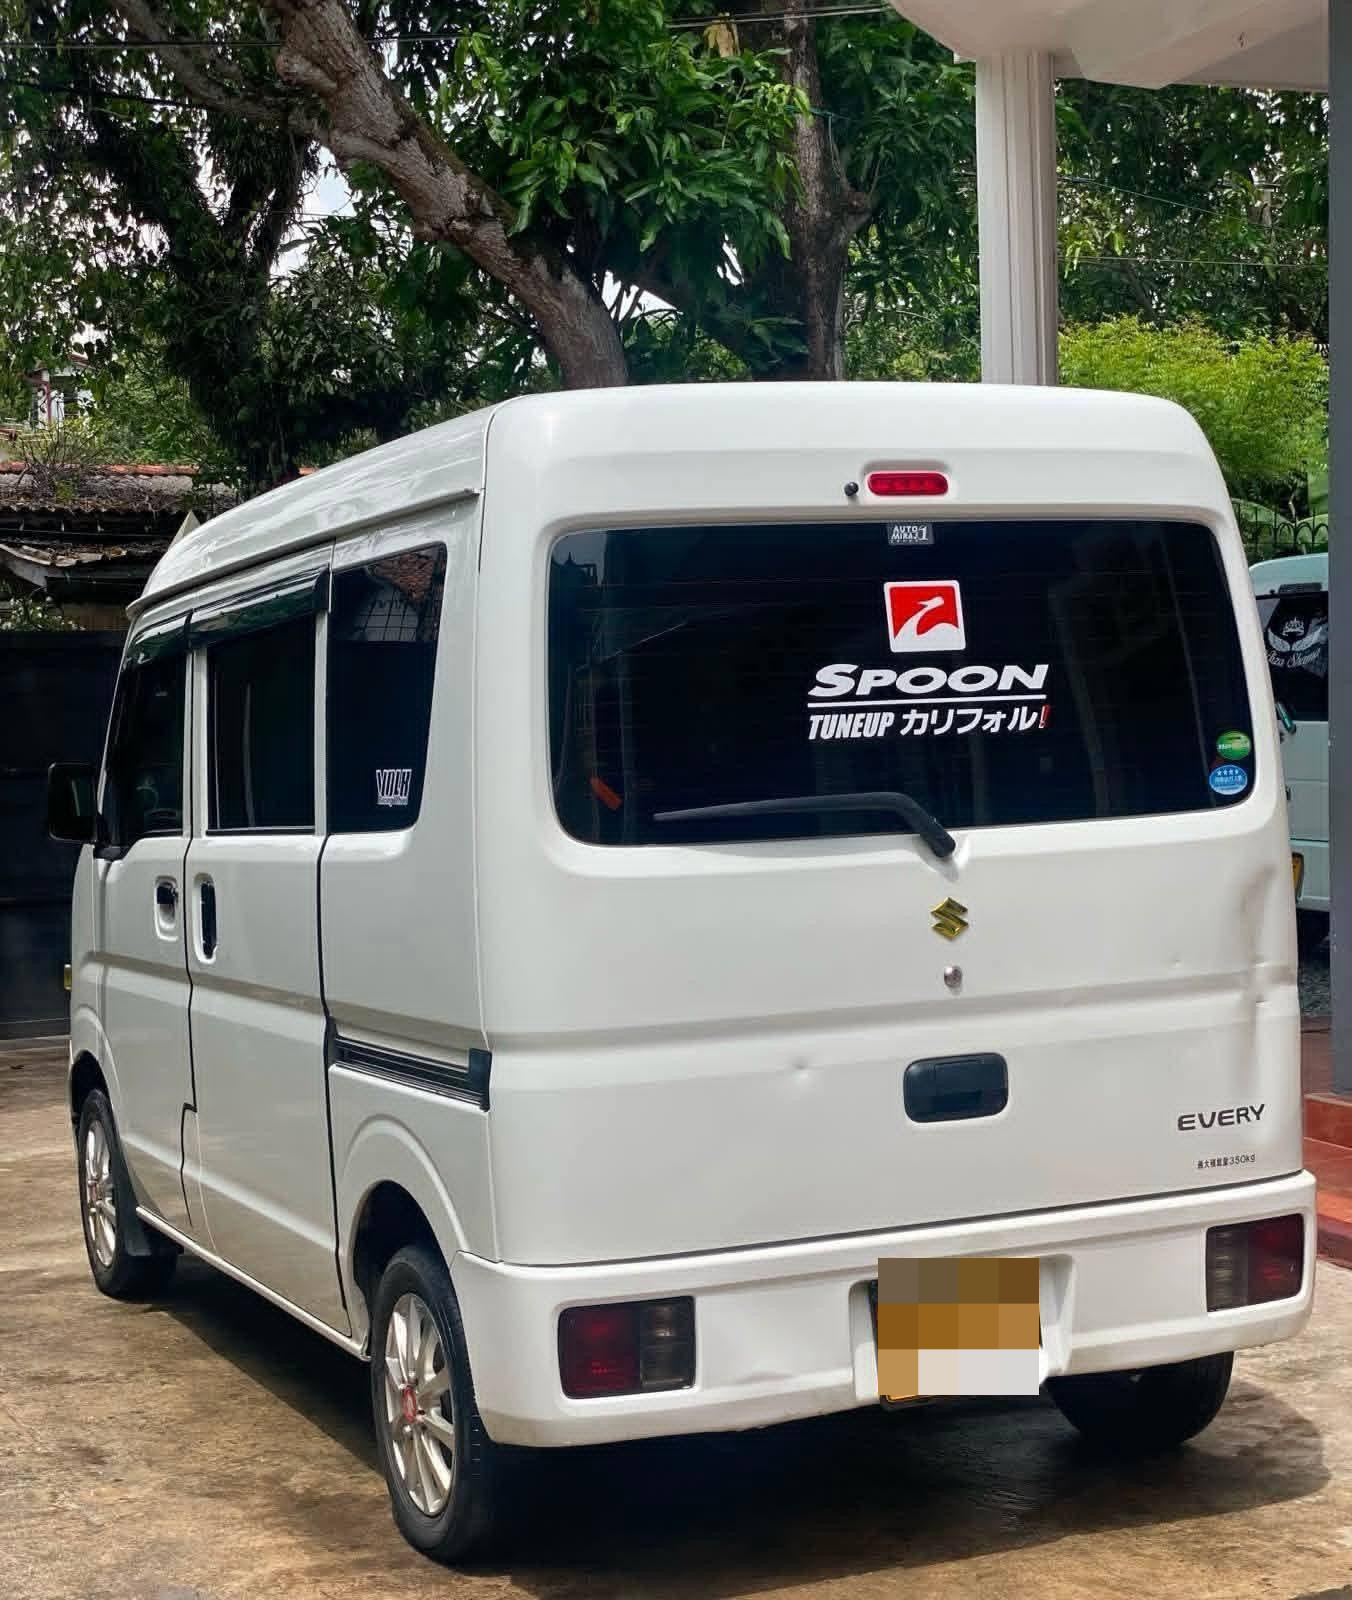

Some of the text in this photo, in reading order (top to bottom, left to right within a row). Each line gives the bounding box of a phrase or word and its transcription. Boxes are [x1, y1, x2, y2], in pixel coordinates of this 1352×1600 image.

[893, 524, 918, 533] AUTO
[808, 664, 1049, 697] SPOON
[808, 711, 895, 740] TUNEUP
[1177, 1103, 1265, 1131] EVERY
